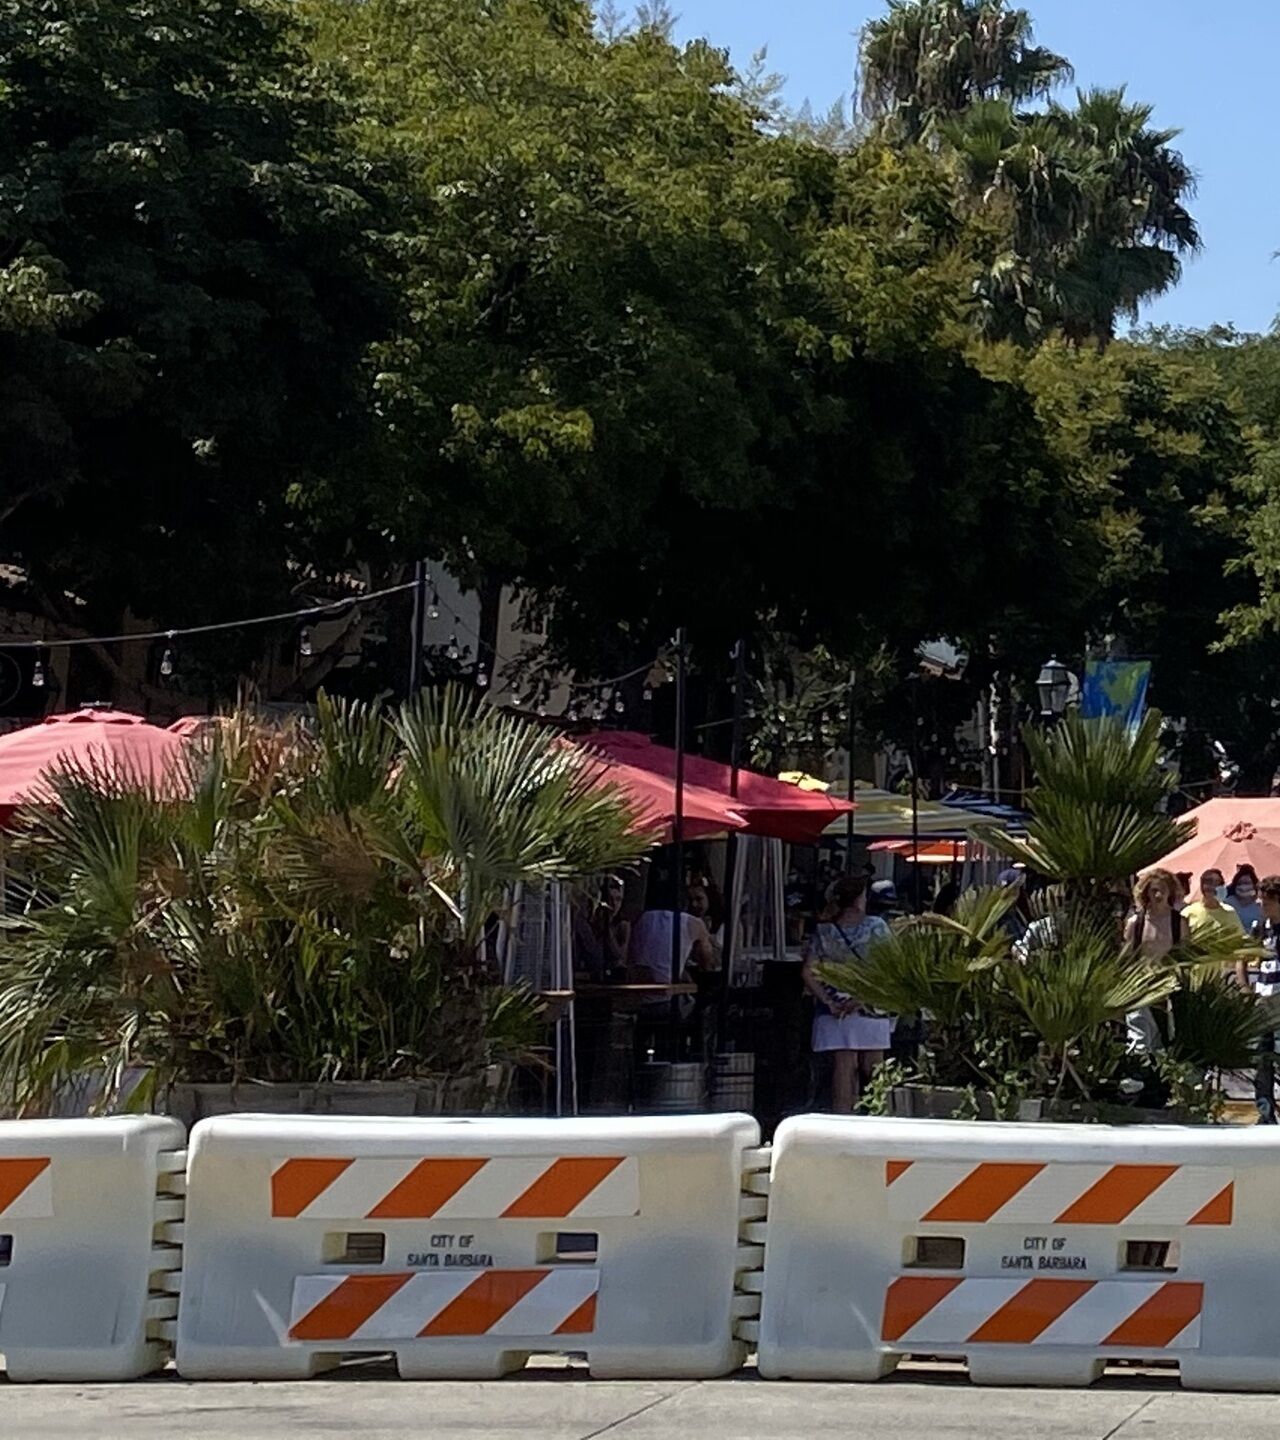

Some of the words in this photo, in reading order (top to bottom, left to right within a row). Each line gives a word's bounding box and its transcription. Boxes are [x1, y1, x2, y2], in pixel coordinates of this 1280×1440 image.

[430, 1234, 455, 1248] CITY
[459, 1234, 474, 1248] OF
[1024, 1237, 1047, 1250] CITY
[1052, 1237, 1067, 1250] OF
[407, 1253, 439, 1266] SANTA
[1001, 1255, 1033, 1269] SANTA
[1038, 1256, 1087, 1270] BARBARA
